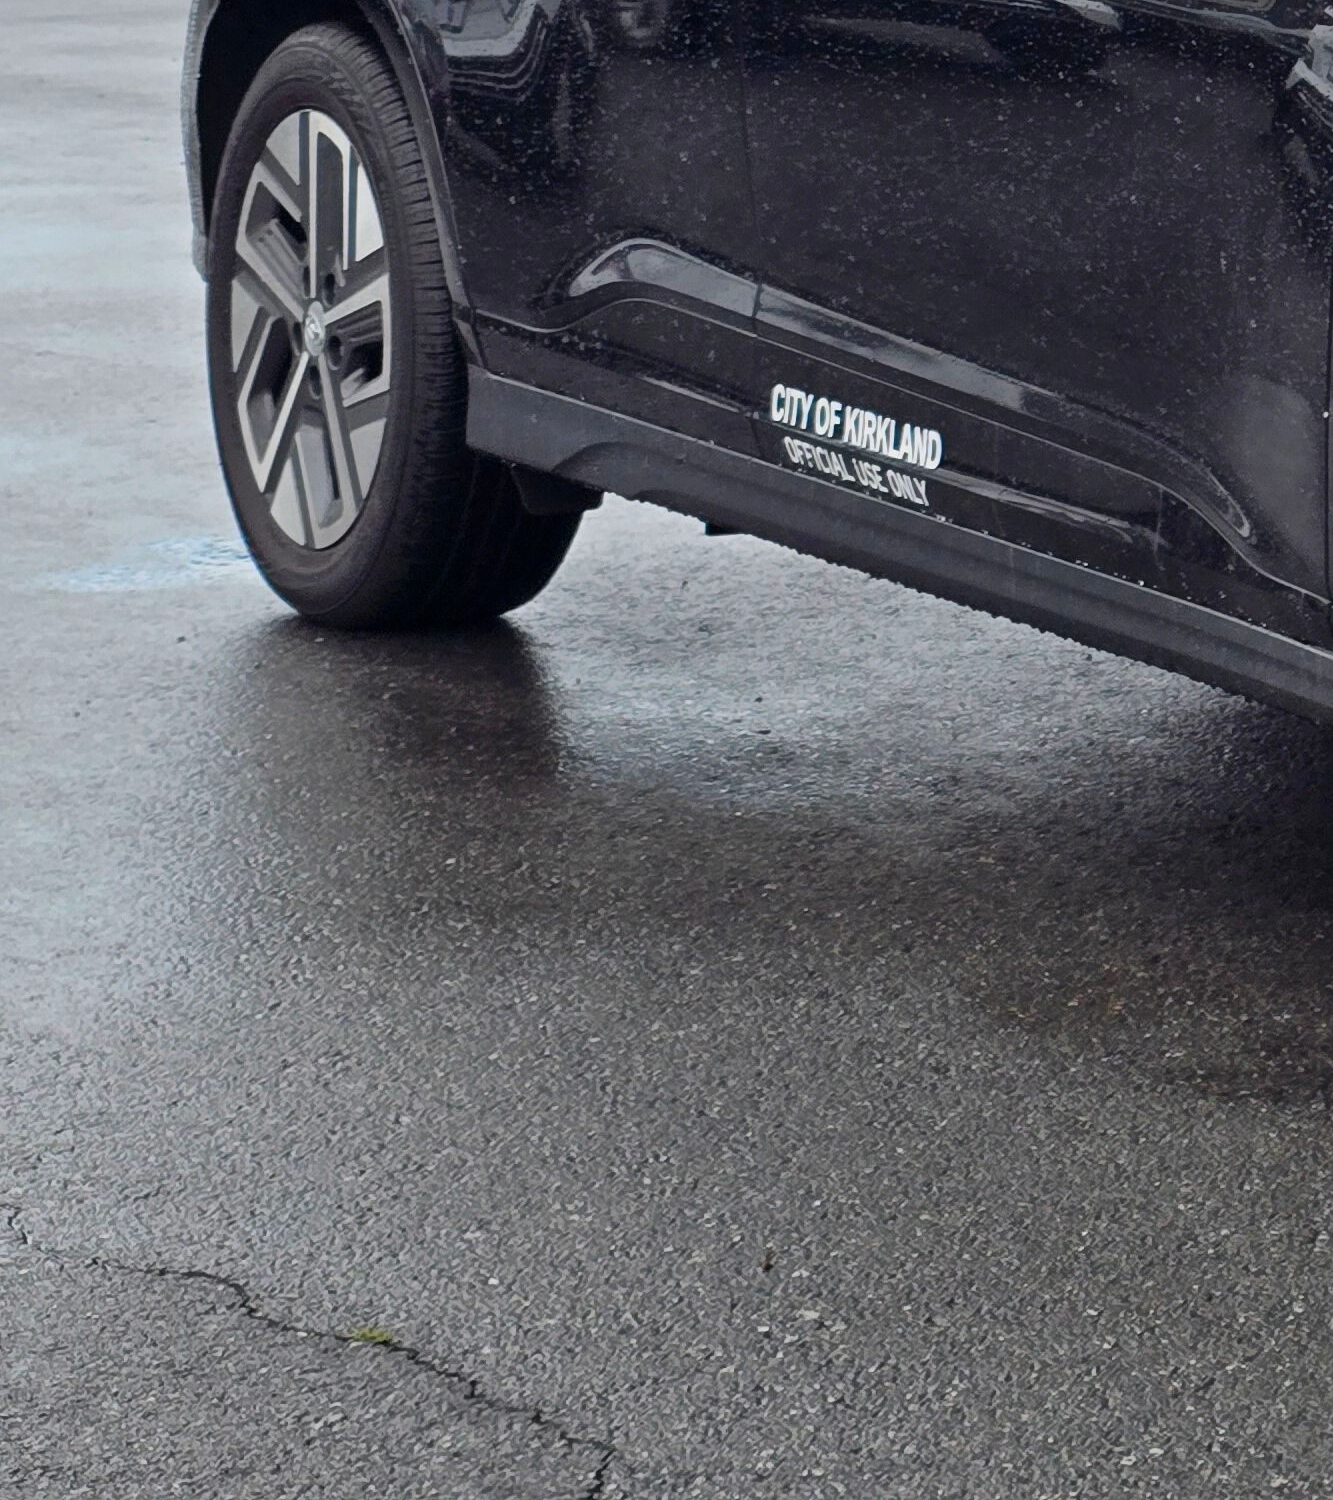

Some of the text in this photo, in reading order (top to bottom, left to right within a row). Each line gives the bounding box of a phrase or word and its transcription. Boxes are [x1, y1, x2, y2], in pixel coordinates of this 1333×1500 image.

[771, 383, 942, 470] CITY OF KIRKLAND
[783, 436, 929, 507] OFFICIAL USE ONLY
